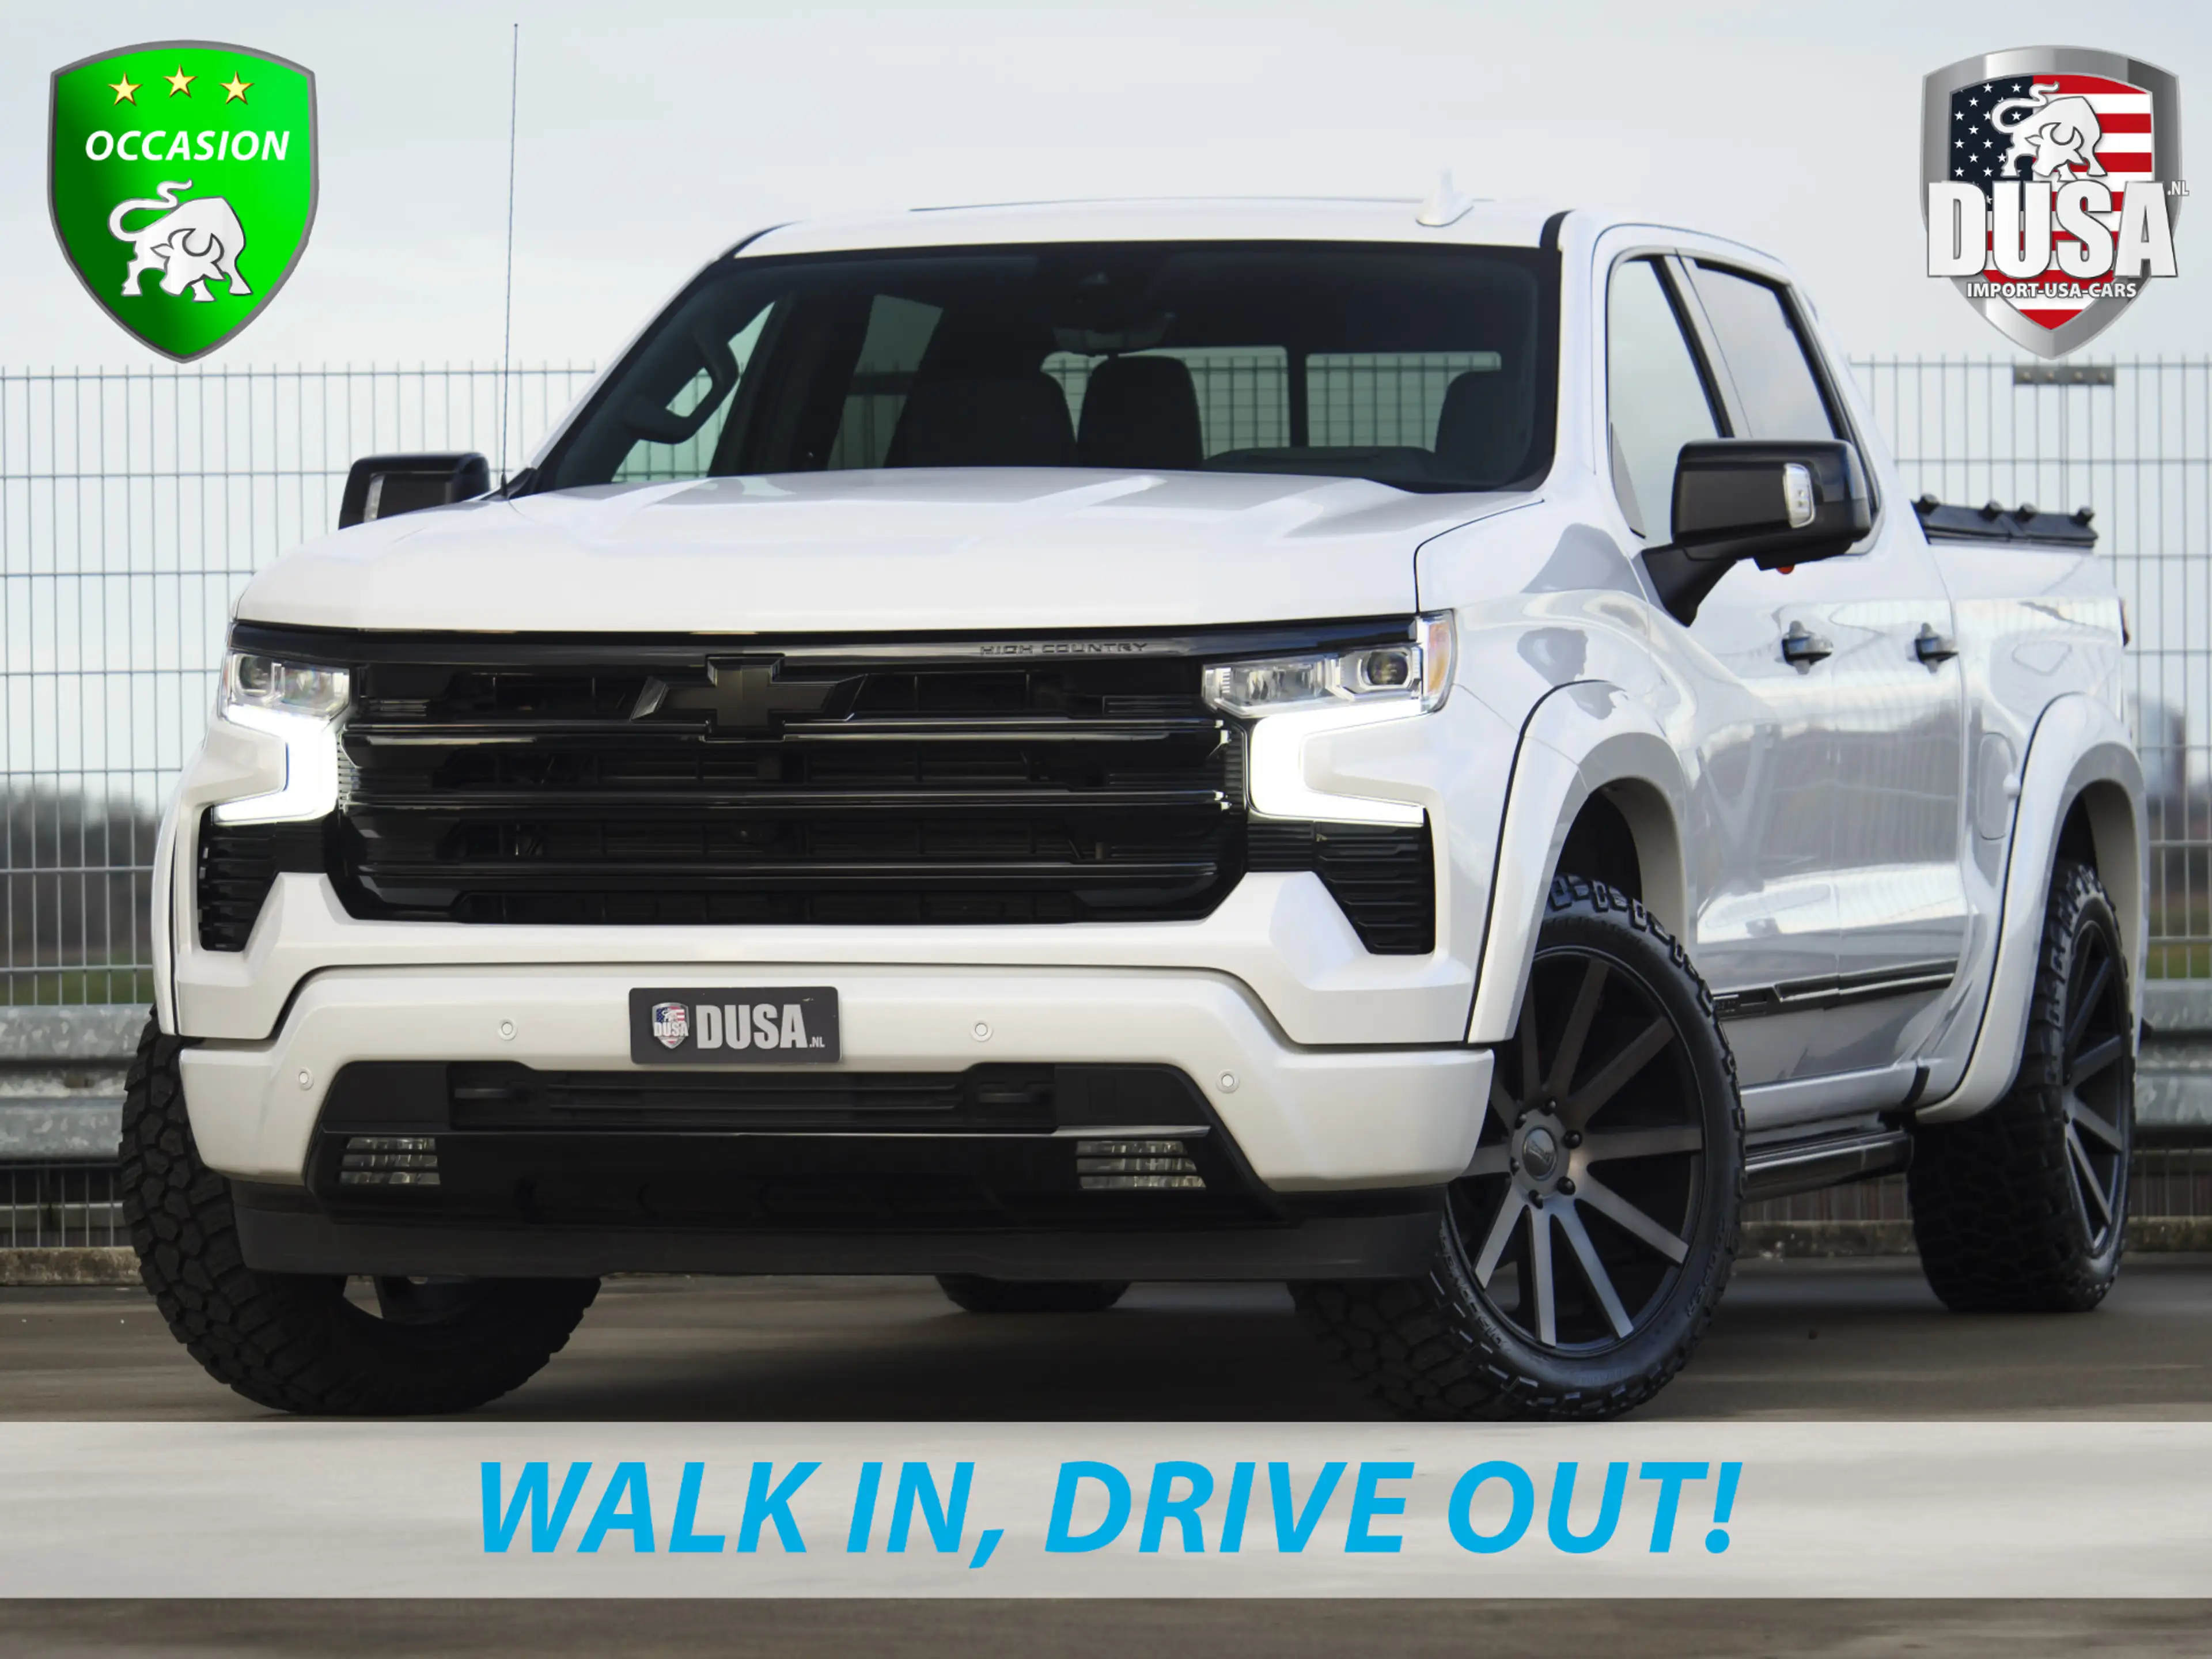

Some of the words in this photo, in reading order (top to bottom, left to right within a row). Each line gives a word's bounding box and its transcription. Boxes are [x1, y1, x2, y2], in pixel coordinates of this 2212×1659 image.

[979, 645, 1033, 656] HIGH
[1041, 642, 1148, 653] COUNTRY
[654, 1021, 689, 1037] DUSA
